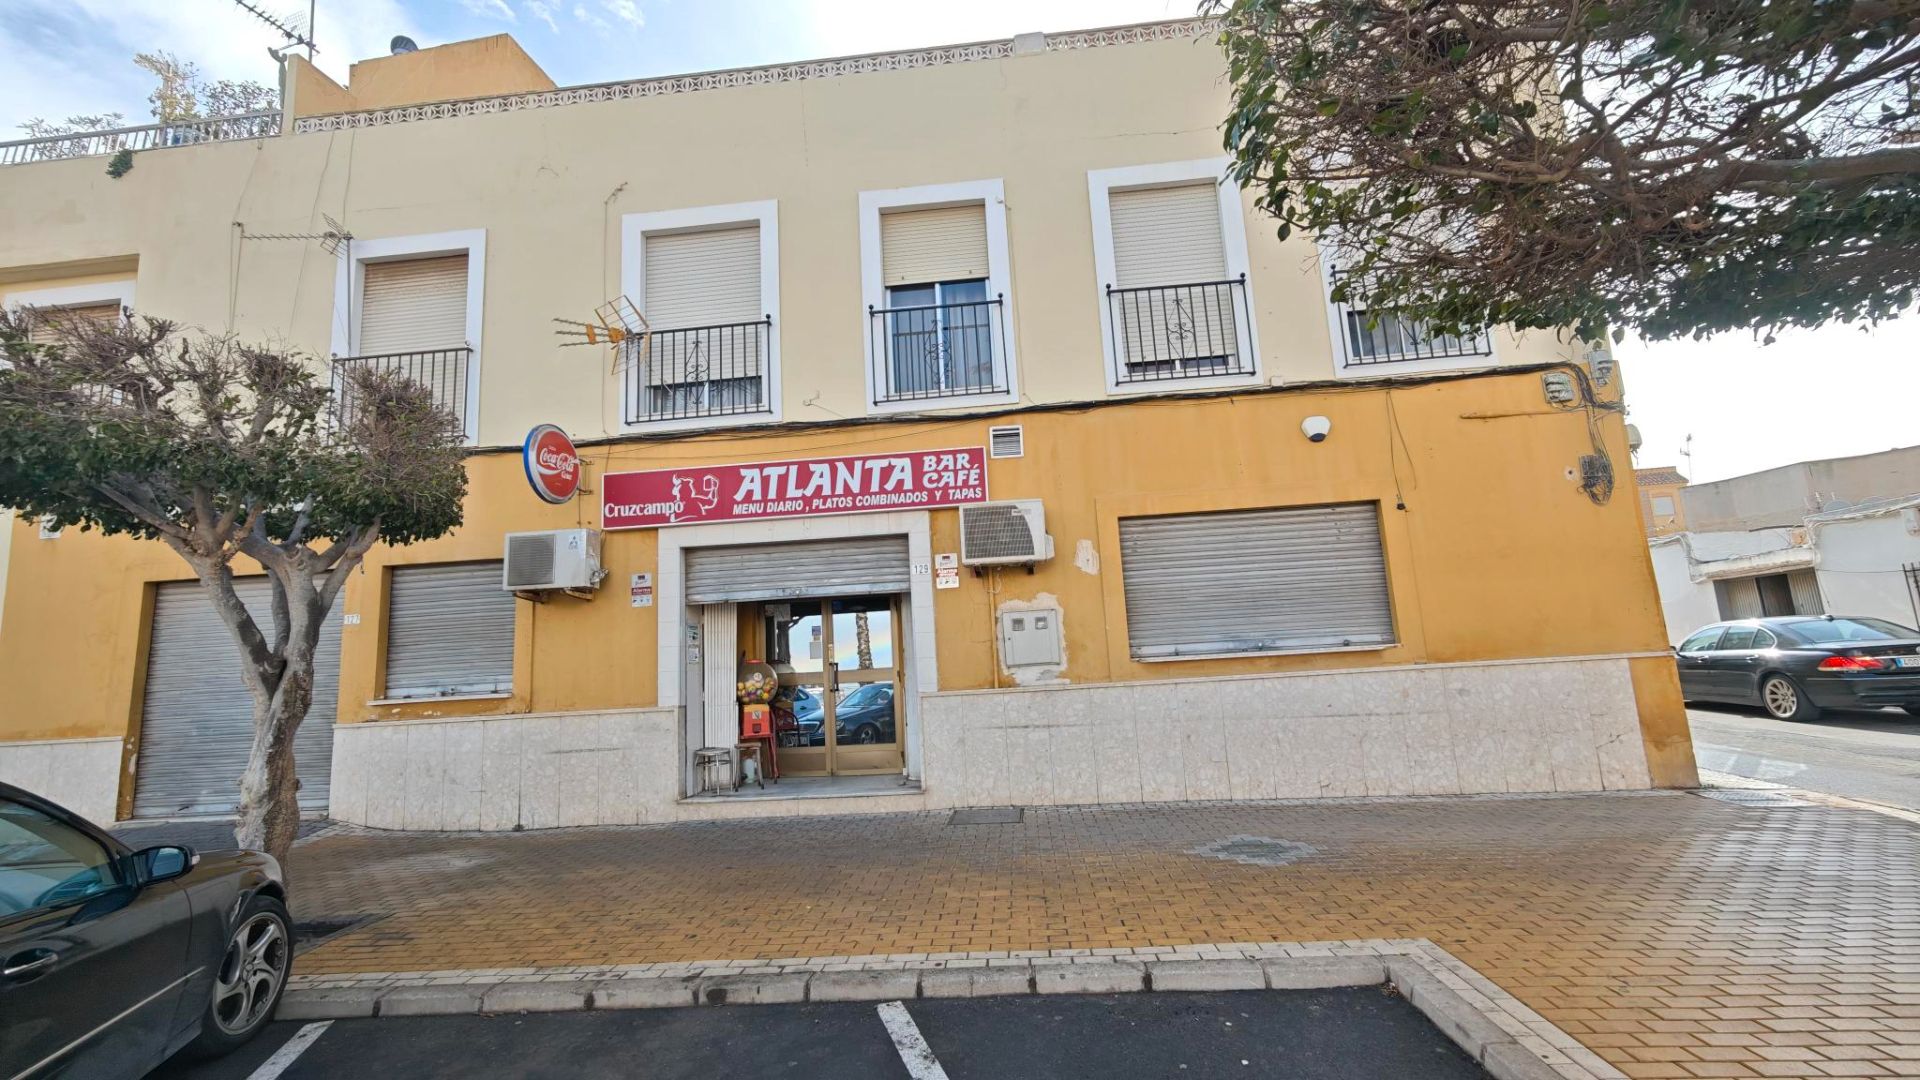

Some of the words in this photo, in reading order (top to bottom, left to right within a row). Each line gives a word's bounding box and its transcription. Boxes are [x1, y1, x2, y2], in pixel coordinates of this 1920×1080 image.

[540, 447, 577, 472] Coca-Cola
[923, 453, 971, 471] BAR
[733, 457, 913, 501] ATLANTA
[922, 464, 981, 489] CAFÉ
[604, 501, 685, 521] Cruzcampo
[733, 502, 764, 515] MENU
[812, 497, 855, 510] PLATOS
[856, 491, 929, 507] COMBINADOS
[935, 490, 943, 500] Y
[948, 487, 982, 500] TAPAS
[914, 564, 929, 574] 129
